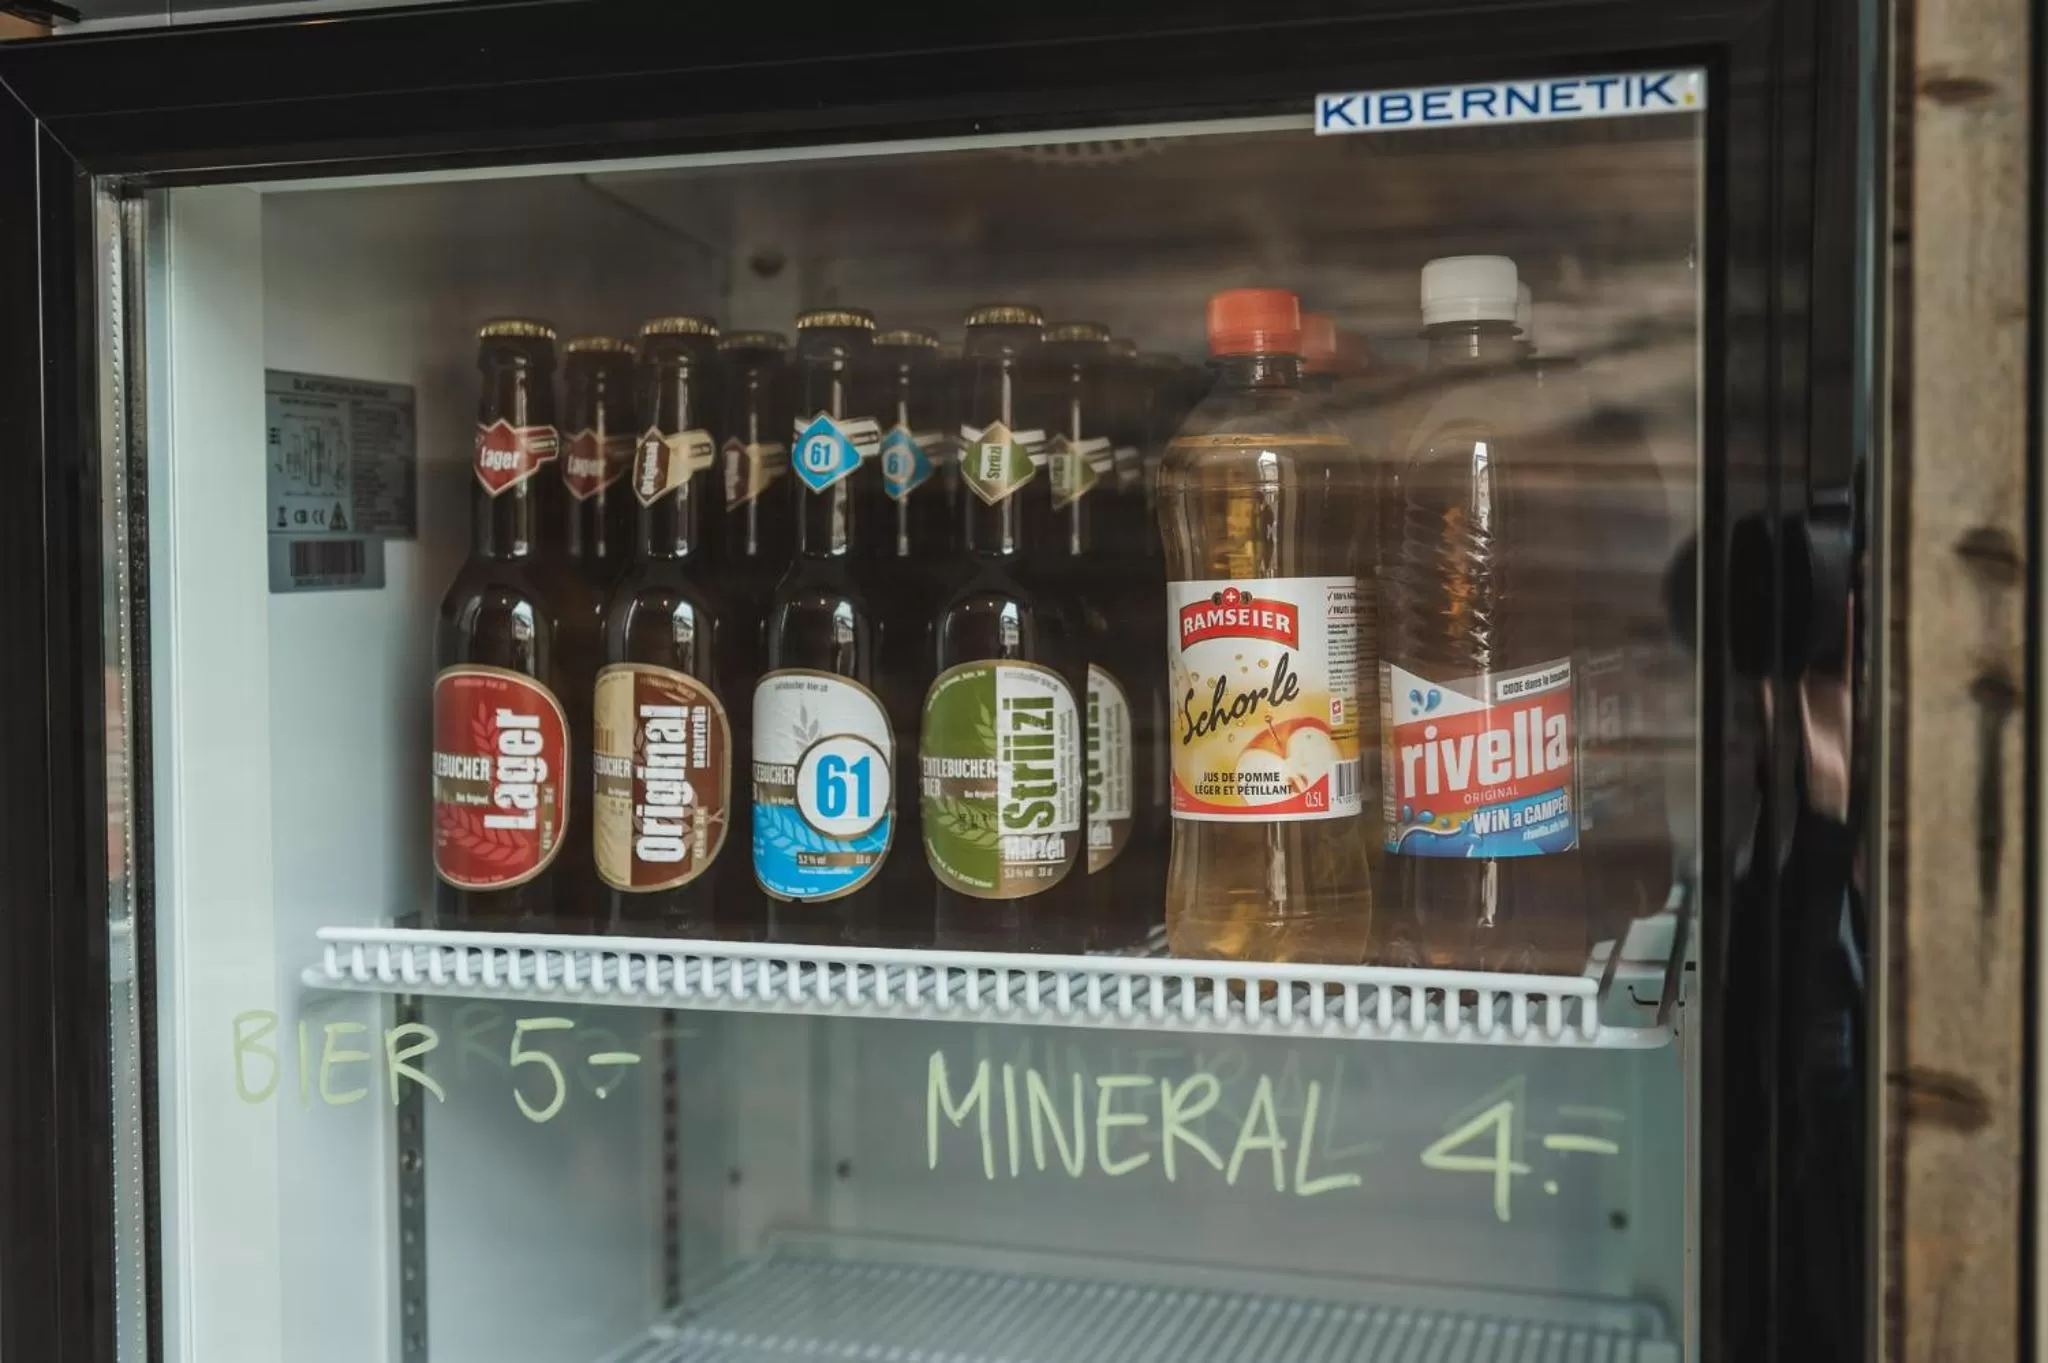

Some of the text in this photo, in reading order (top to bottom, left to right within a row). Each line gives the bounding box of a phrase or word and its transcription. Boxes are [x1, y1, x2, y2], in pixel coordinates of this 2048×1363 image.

[1323, 73, 1677, 128] KIBERNETIK
[480, 446, 521, 471] Lager
[810, 442, 831, 466] 61
[1183, 608, 1291, 637] RAMSEIER
[1183, 652, 1299, 745] Schorle
[1503, 680, 1524, 697] CODE
[483, 708, 548, 830] Lager
[922, 757, 996, 778] ENTLEBUCHER
[1002, 697, 1058, 829] Strizzi
[1400, 706, 1569, 798] rivella
[636, 704, 694, 862] Original
[816, 754, 871, 819] 61
[1203, 771, 1281, 782] JUS DE POMME
[1223, 784, 1235, 795] ET
[1237, 782, 1293, 796] PÉTILLANT
[1463, 784, 1519, 805] ORIGINAL
[1512, 812, 1523, 827] a
[1524, 793, 1569, 824] CAMPER
[231, 1008, 446, 1111] BIER
[928, 1050, 1362, 1196] MINERAL
